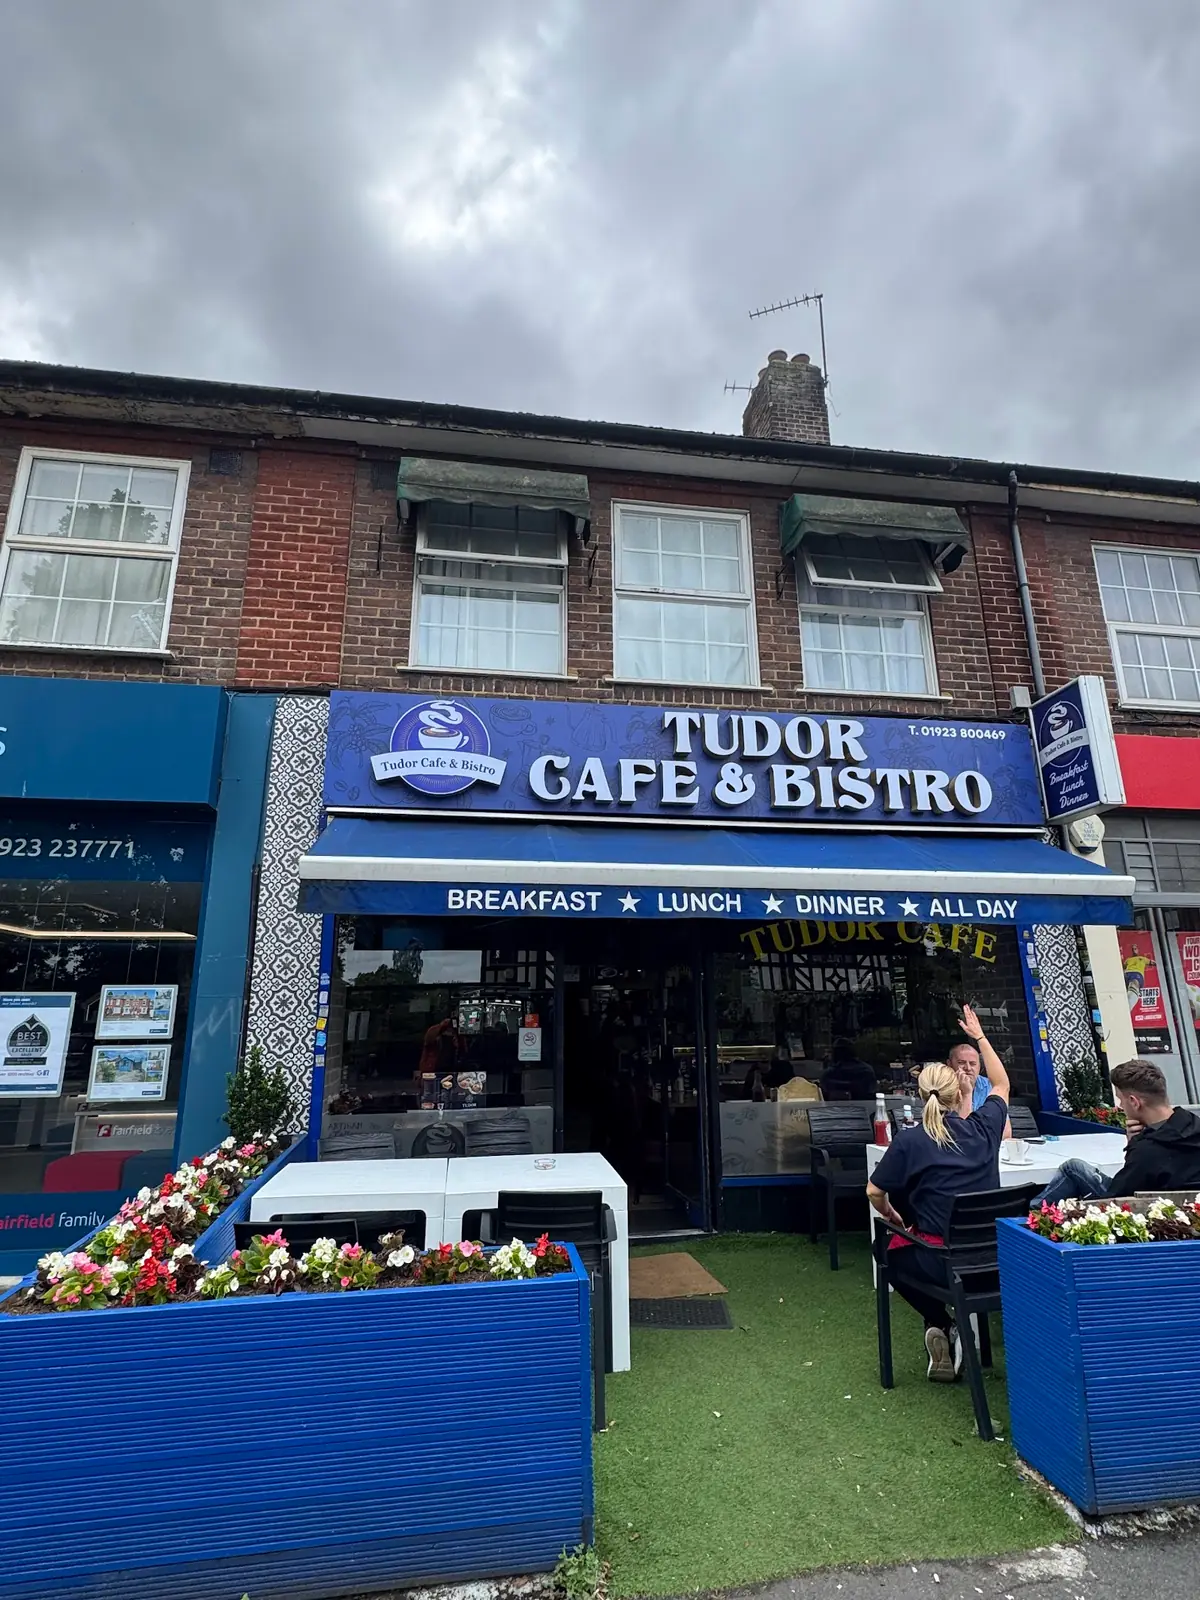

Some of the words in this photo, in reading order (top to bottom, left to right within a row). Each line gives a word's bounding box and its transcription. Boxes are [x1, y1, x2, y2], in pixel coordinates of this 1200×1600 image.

[662, 711, 869, 762] TUDOR
[921, 726, 957, 738] 01923
[960, 728, 1006, 740] 800469
[380, 758, 418, 772] Tudor
[420, 757, 447, 768] Cafe
[449, 758, 458, 769] &
[461, 759, 496, 776] Bistro
[1049, 760, 1089, 786] Breakfast
[529, 754, 699, 805] CAFE
[712, 762, 757, 806] &
[769, 764, 993, 814] BISTRO
[1059, 776, 1085, 795] Lunch
[1059, 792, 1089, 808] Dinner
[48, 839, 135, 859] 237771
[447, 889, 602, 912] BREAKFAST
[658, 892, 743, 913] LUNCH
[796, 894, 885, 916] DINNER
[929, 898, 973, 918] ALL
[976, 899, 1018, 919] DAY
[740, 920, 884, 961] TUDOR
[896, 922, 998, 964] CAFE
[1139, 988, 1159, 997] STARTS
[1142, 997, 1156, 1006] HERE
[17, 1031, 42, 1040] BEST
[112, 1124, 153, 1137] fairfield
[58, 1211, 105, 1228] family
